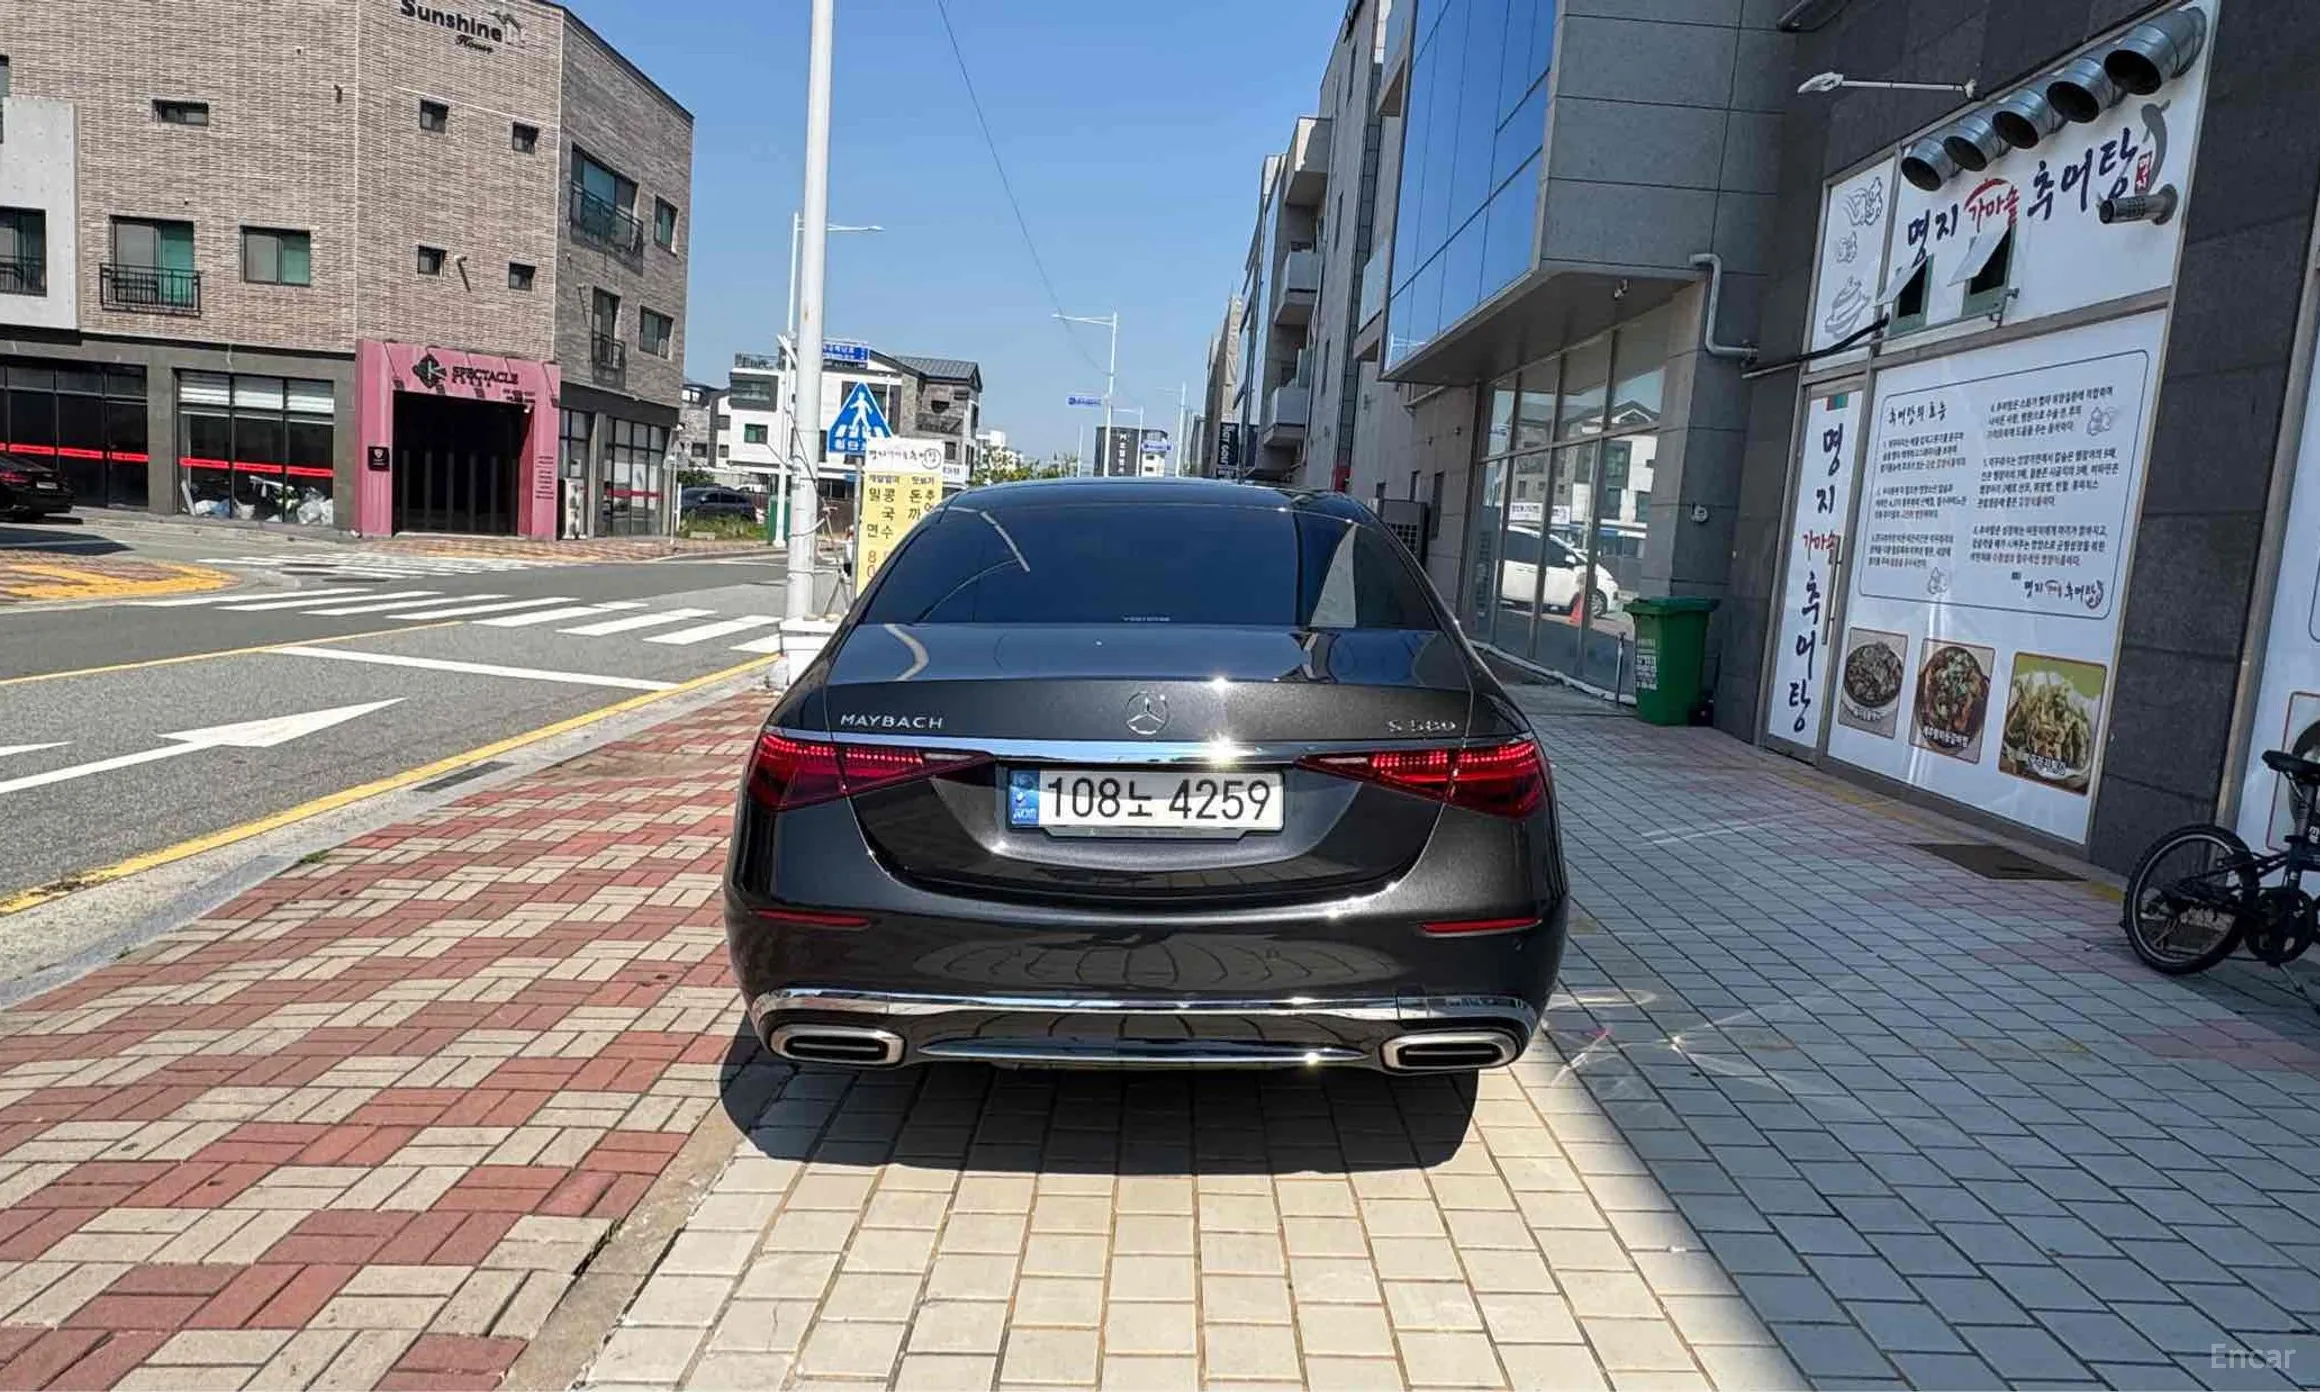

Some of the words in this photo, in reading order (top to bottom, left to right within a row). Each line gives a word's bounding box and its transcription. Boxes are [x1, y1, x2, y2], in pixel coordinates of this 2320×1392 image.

[400, 0, 503, 42] Sunshine
[1908, 204, 1958, 267] 명지
[1967, 184, 2020, 232] 가마솥
[2027, 127, 2138, 220] 추어탕
[453, 366, 519, 385] SPECTACLE
[1816, 423, 1844, 514] 명지
[881, 488, 895, 539] 콩국수
[908, 489, 922, 520] 돈까
[1789, 571, 1821, 732] 추어탕
[840, 714, 943, 729] MAYBACH
[1410, 719, 1457, 732] 580
[1048, 777, 1152, 818] 108노
[1169, 779, 1271, 820] 4259
